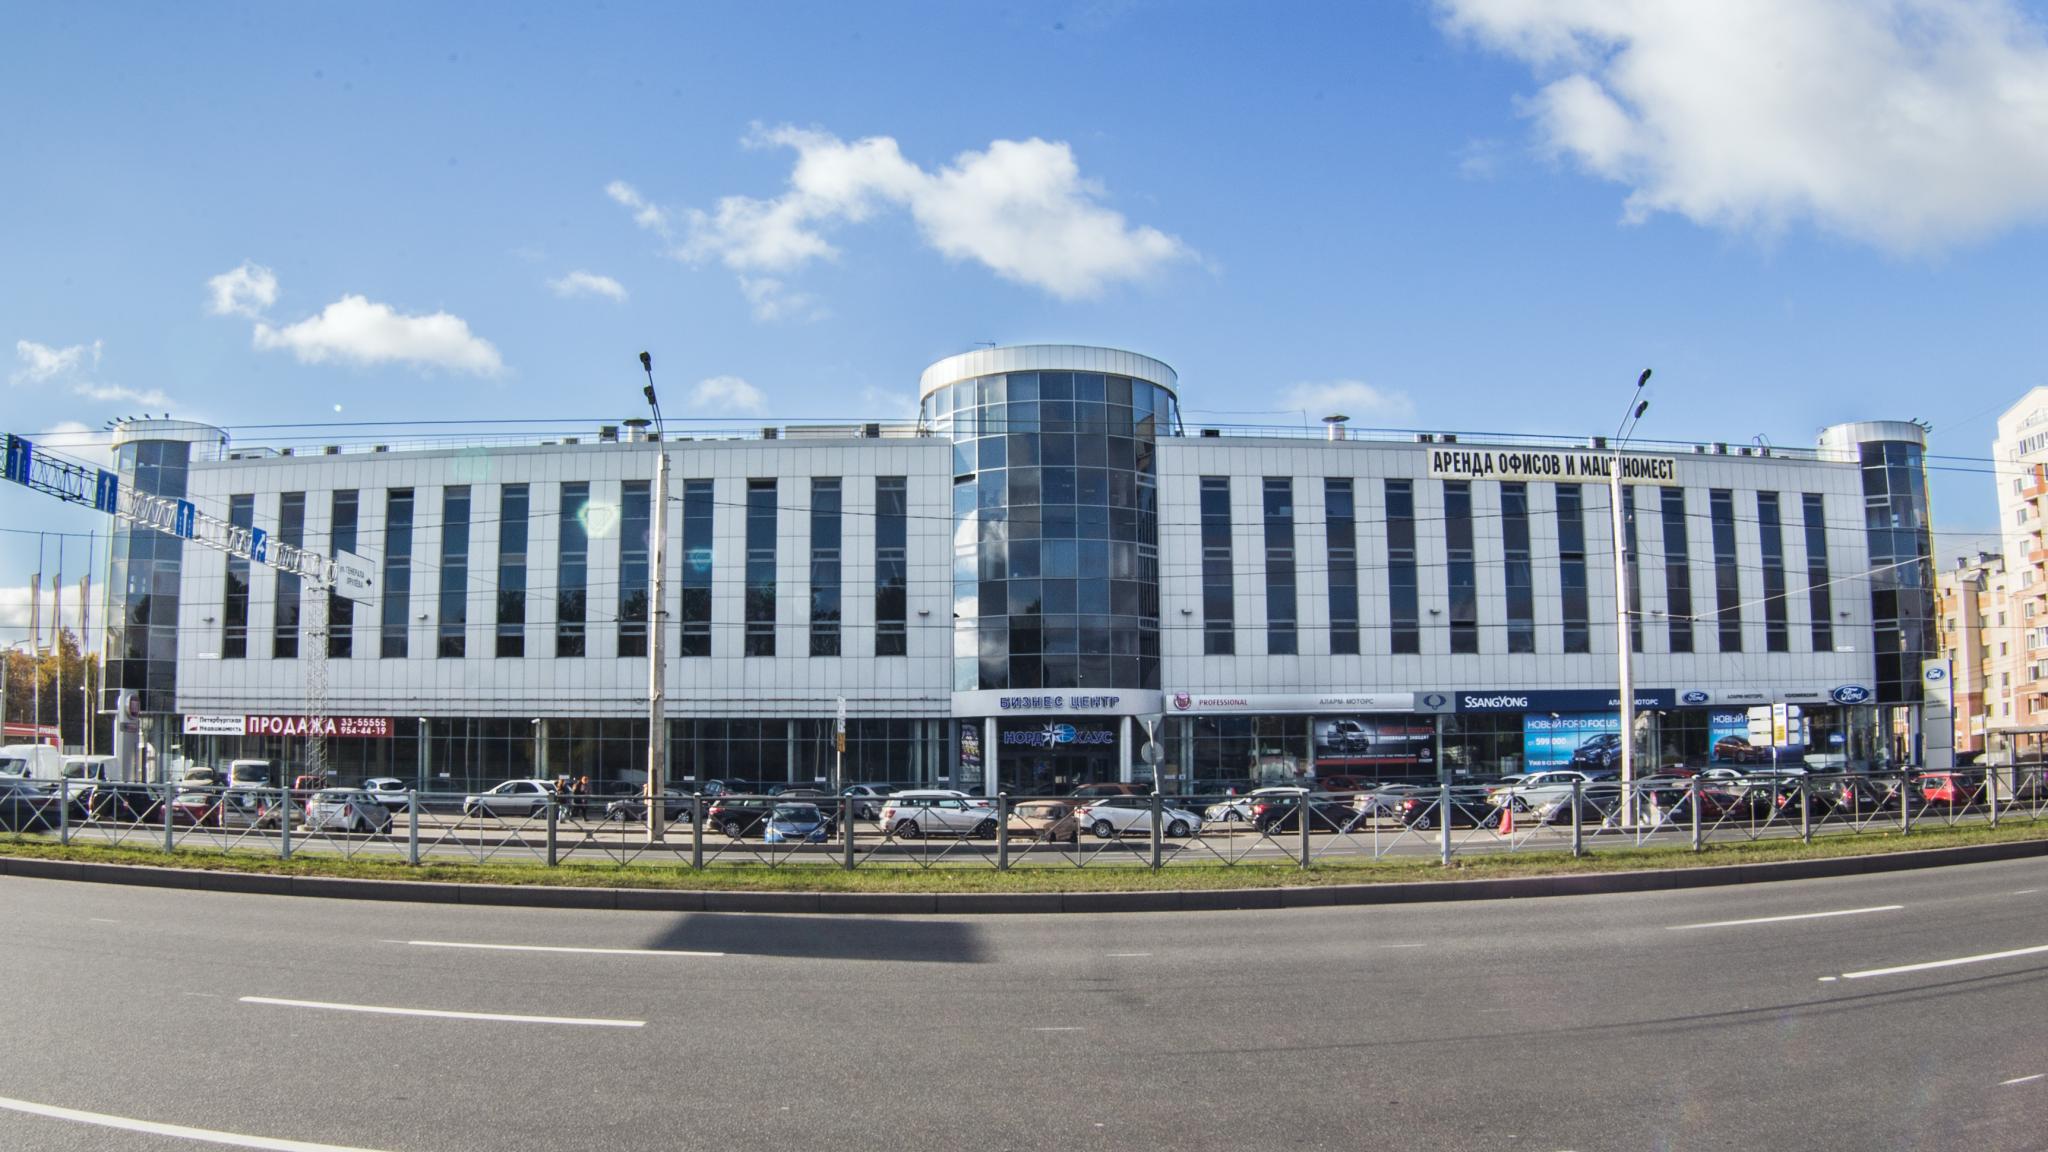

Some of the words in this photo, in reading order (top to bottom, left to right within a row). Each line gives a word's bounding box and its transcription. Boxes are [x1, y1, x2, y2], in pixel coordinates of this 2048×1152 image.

[1433, 451, 1494, 477] АРЕНДА
[1499, 452, 1561, 476] ОФИСОВ
[1566, 455, 1576, 475] И
[1000, 696, 1063, 709] БИЗНЕС
[1070, 696, 1120, 709] ЦЕНТР
[340, 718, 386, 726] 33-55555
[1527, 719, 1561, 729] НОВЫЙ
[1587, 719, 1618, 728] FOCUS
[1712, 713, 1744, 724] НОВЫЙ
[249, 717, 337, 735] ПРОДАЖА
[340, 726, 387, 735] 954-44-19
[1003, 731, 1045, 746] НОРД
[1072, 731, 1113, 744] ХАУС
